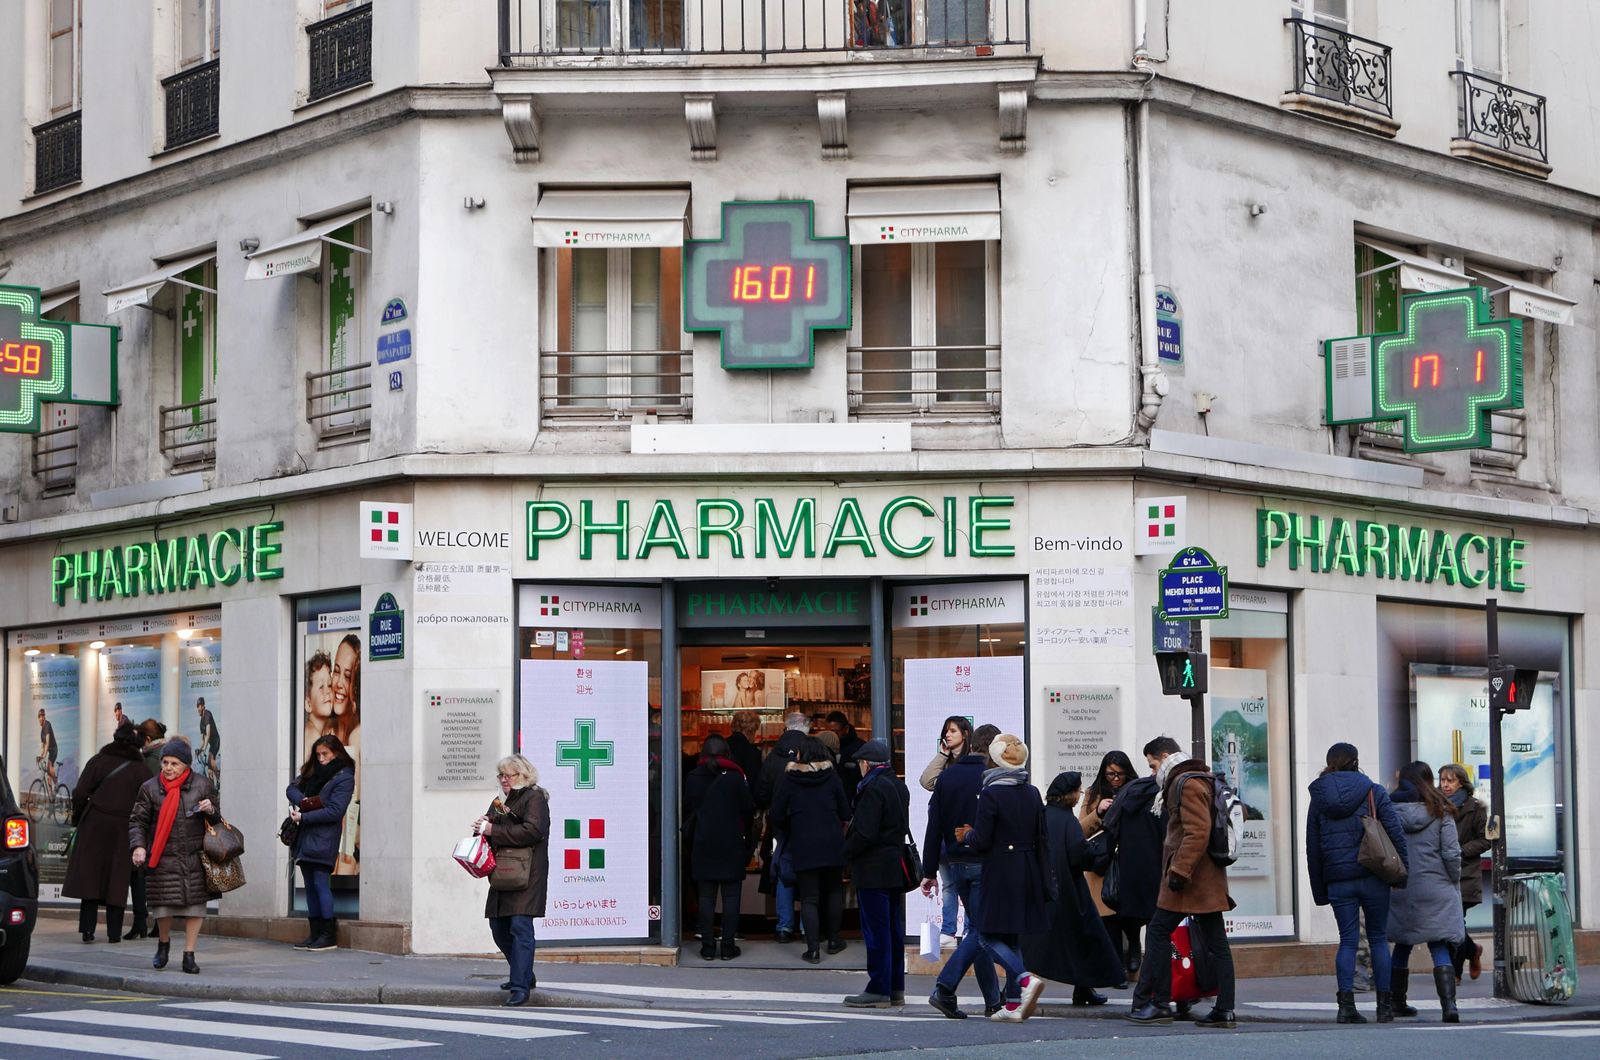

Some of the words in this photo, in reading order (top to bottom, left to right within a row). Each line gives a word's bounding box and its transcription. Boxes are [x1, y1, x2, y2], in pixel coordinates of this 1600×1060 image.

[584, 232, 652, 242] CITYPHARMA
[900, 226, 968, 238] CITYPHARMA
[275, 255, 311, 272] CITYPHARMA
[1157, 326, 1172, 338] RUE
[387, 333, 401, 345] RUE
[378, 344, 411, 360] BONAPARTE
[1160, 341, 1180, 354] FOUR
[526, 495, 1015, 560] PHARMACIE
[418, 530, 509, 548] WELCOME
[1034, 536, 1123, 551] Bem-vindo
[1257, 508, 1532, 593] PHARMACIE
[52, 520, 284, 607] PHARMACIE
[1081, 568, 1096, 576] 오신
[1182, 576, 1204, 584] PLACE
[1066, 590, 1080, 598] 가장
[1165, 588, 1184, 596] MEHDI
[1185, 588, 1198, 596] BEN
[1199, 586, 1221, 594] BARKA
[687, 591, 860, 617] PHARMACIE
[930, 597, 1006, 612] CITYPHARMA
[1231, 594, 1267, 605] CITYPHARMA
[562, 600, 642, 614] CITYPHARMA
[380, 619, 392, 631] RUE
[417, 614, 448, 624] добро
[450, 615, 509, 623] пожаловать
[370, 633, 402, 646] BONAPARTE
[1164, 637, 1182, 648] FOUR
[186, 668, 214, 677] commencer
[576, 668, 593, 679] 환영
[955, 666, 971, 676] 환영
[1241, 702, 1264, 712] VICHY
[554, 900, 617, 910] いらっしゃいませ
[1236, 922, 1273, 930] CITYPHARMA
